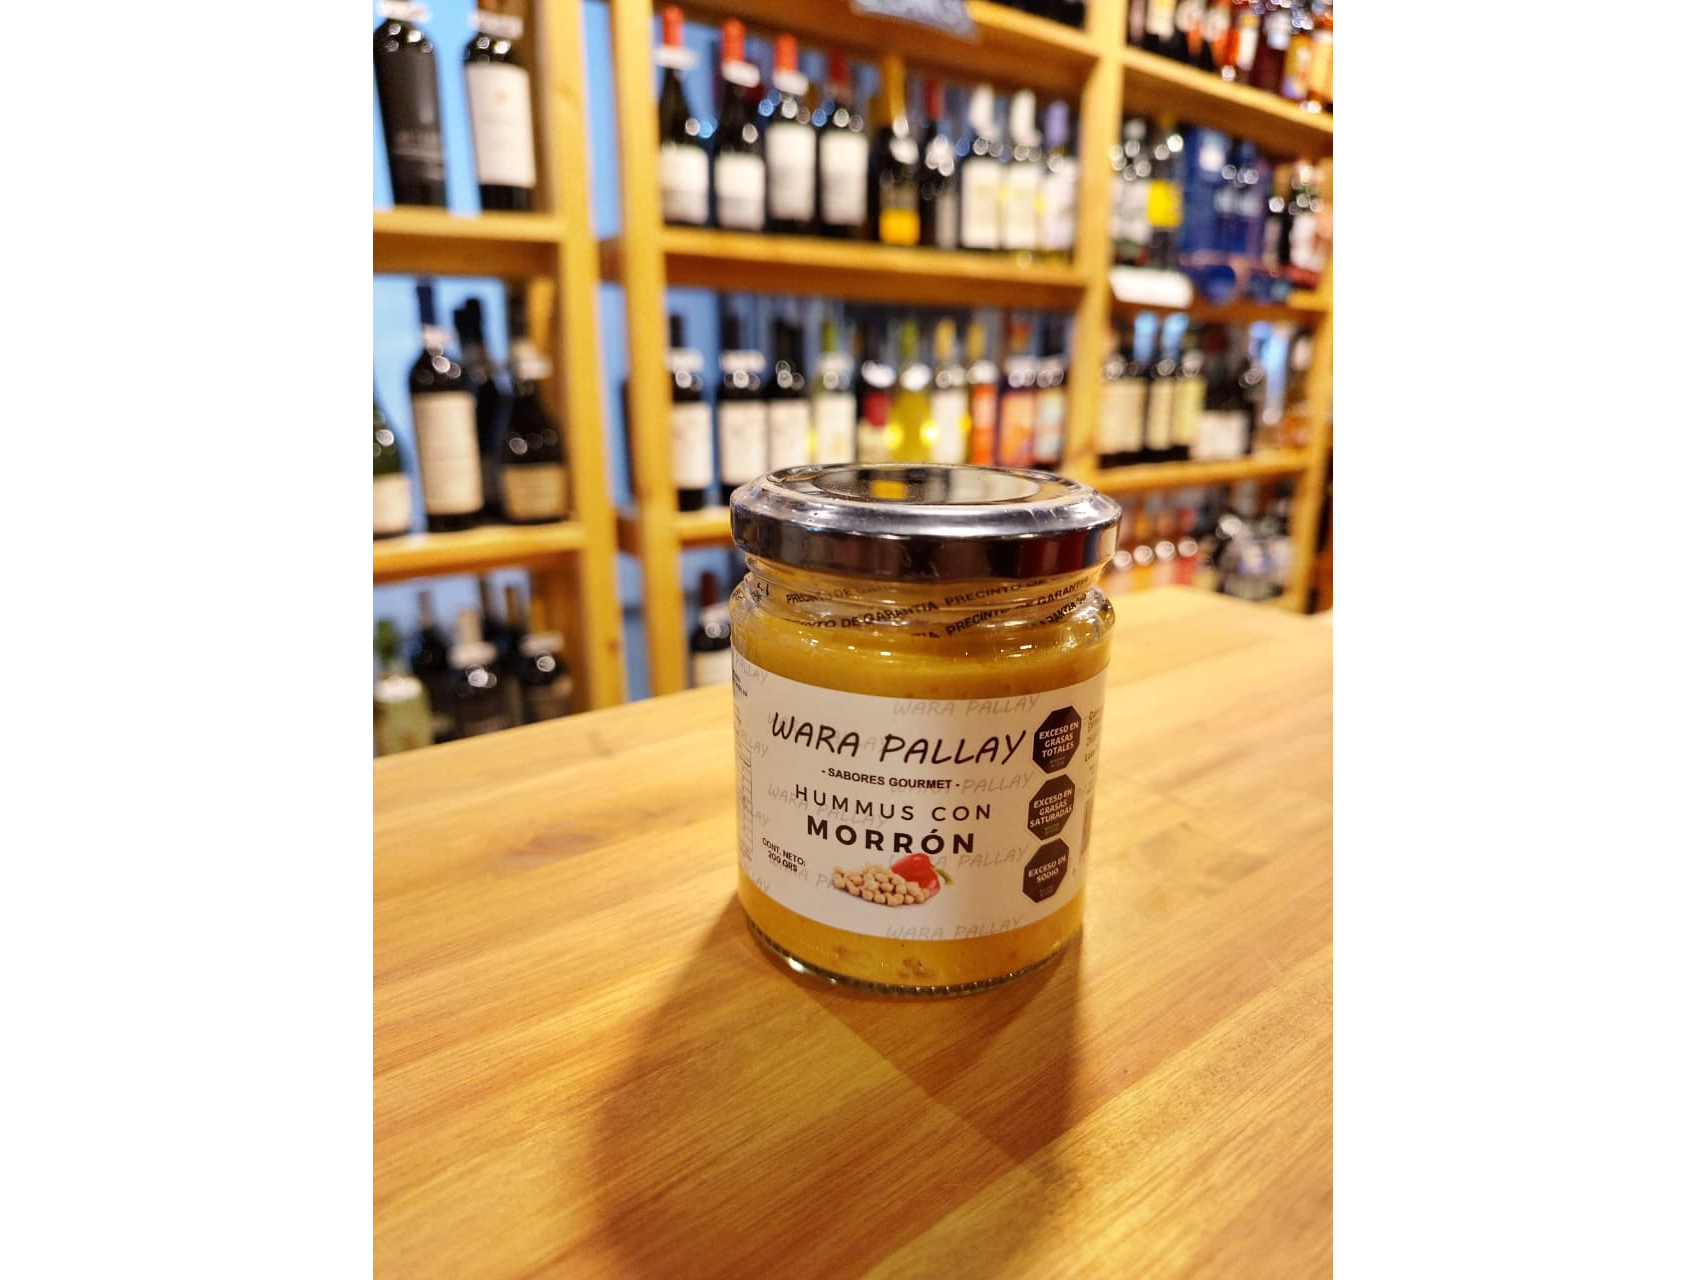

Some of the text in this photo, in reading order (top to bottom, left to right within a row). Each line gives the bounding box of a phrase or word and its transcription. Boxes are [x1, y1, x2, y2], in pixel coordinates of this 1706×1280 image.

[944, 582, 1021, 607] PRECINTO
[892, 694, 1040, 717] WARA PALLAY
[771, 710, 860, 758] WARA
[879, 730, 1027, 766] PALLAY
[1038, 724, 1069, 740] EXCESO
[1069, 720, 1080, 731] EN
[1044, 733, 1074, 748] GRASAS
[1041, 742, 1075, 758] TOTALES
[828, 767, 885, 786] SABORES
[888, 777, 953, 790] GOURMET
[961, 771, 1035, 795] PALLAY
[795, 783, 915, 821] HUMMUS
[931, 803, 991, 822] CON
[1033, 788, 1073, 809] EXCESO EN
[1039, 800, 1068, 816] GRASAS
[1029, 806, 1073, 829] SATURADAS
[807, 814, 974, 855] MORRÓN
[768, 850, 781, 865] 200
[957, 843, 1029, 870] PALLAY
[1028, 855, 1067, 878] EXCESO EN
[1036, 867, 1059, 883] SODIO
